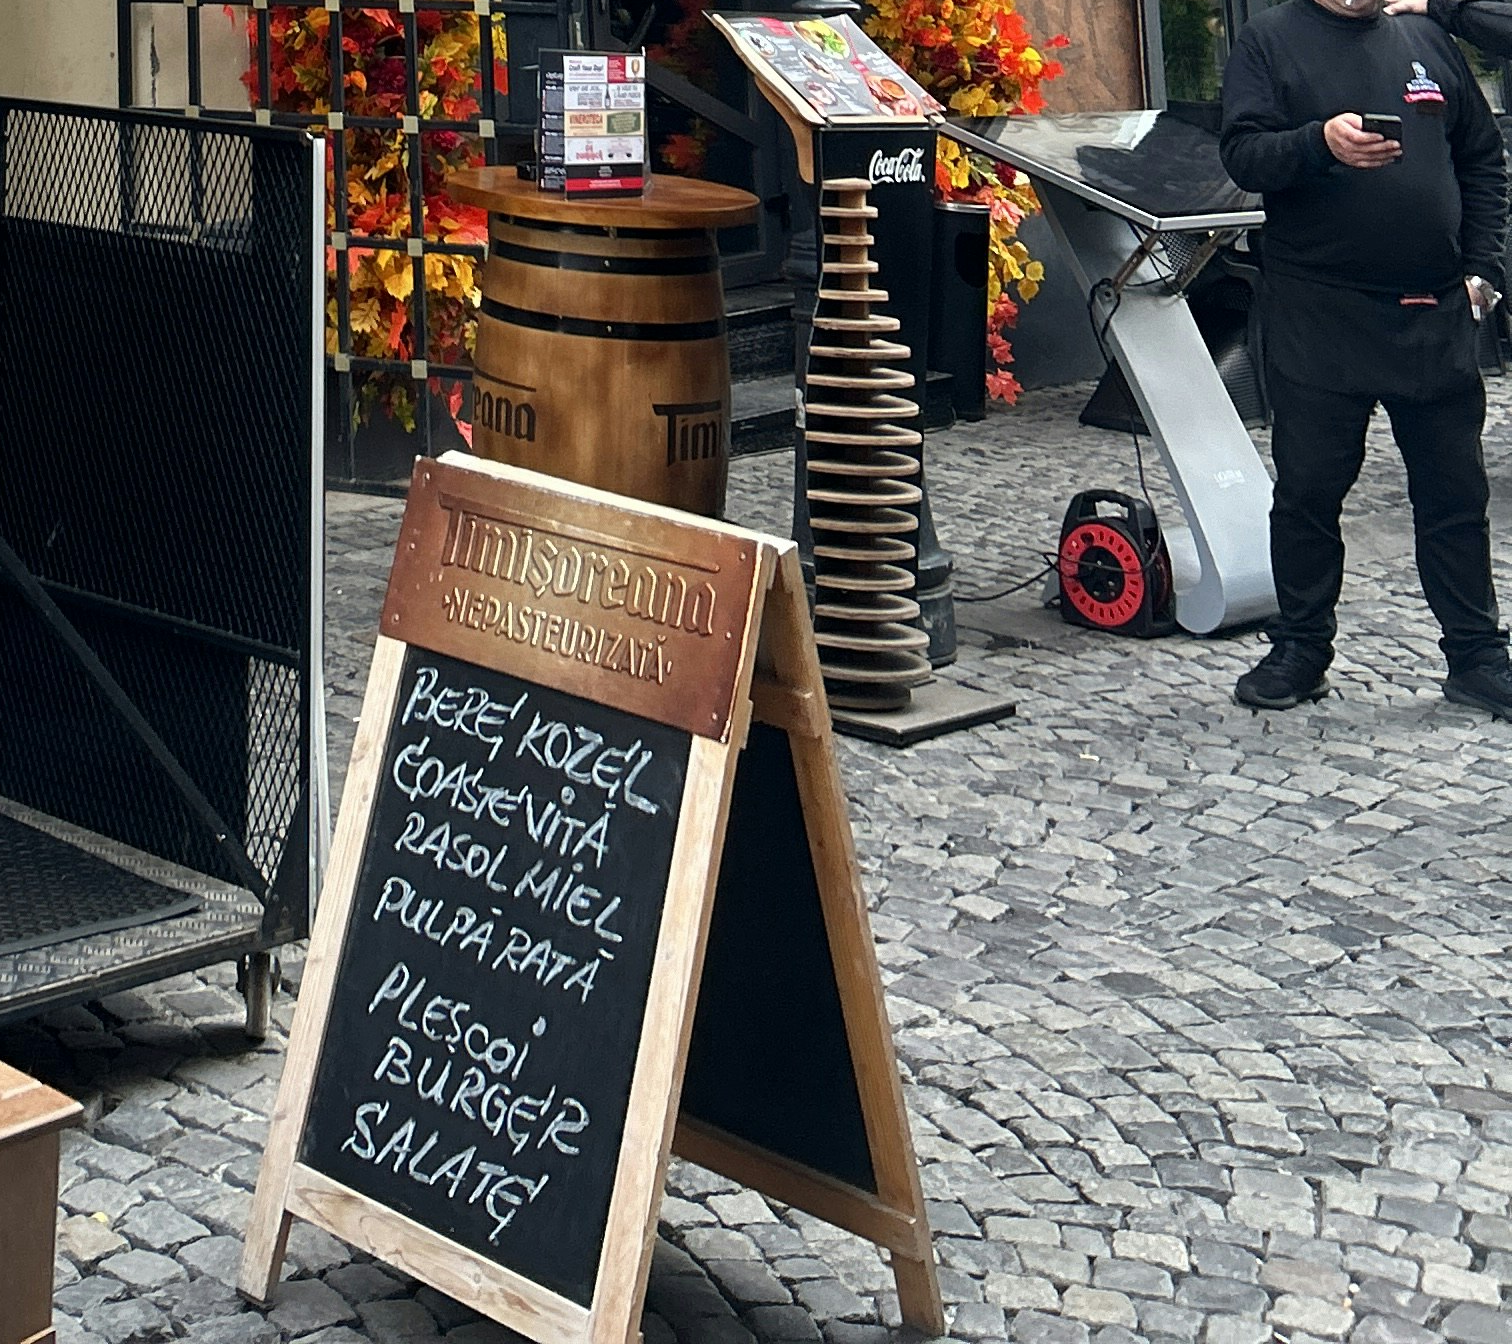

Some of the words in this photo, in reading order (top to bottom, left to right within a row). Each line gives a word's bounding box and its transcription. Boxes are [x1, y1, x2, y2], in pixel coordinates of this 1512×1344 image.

[869, 148, 925, 185] Coca-Cola
[393, 737, 529, 827] COASTE
[402, 667, 529, 761] BERE
[515, 711, 659, 815] KOZEL
[394, 812, 508, 893] RASOL
[373, 1035, 590, 1156] BURGER
[340, 1100, 549, 1242] SALATE
